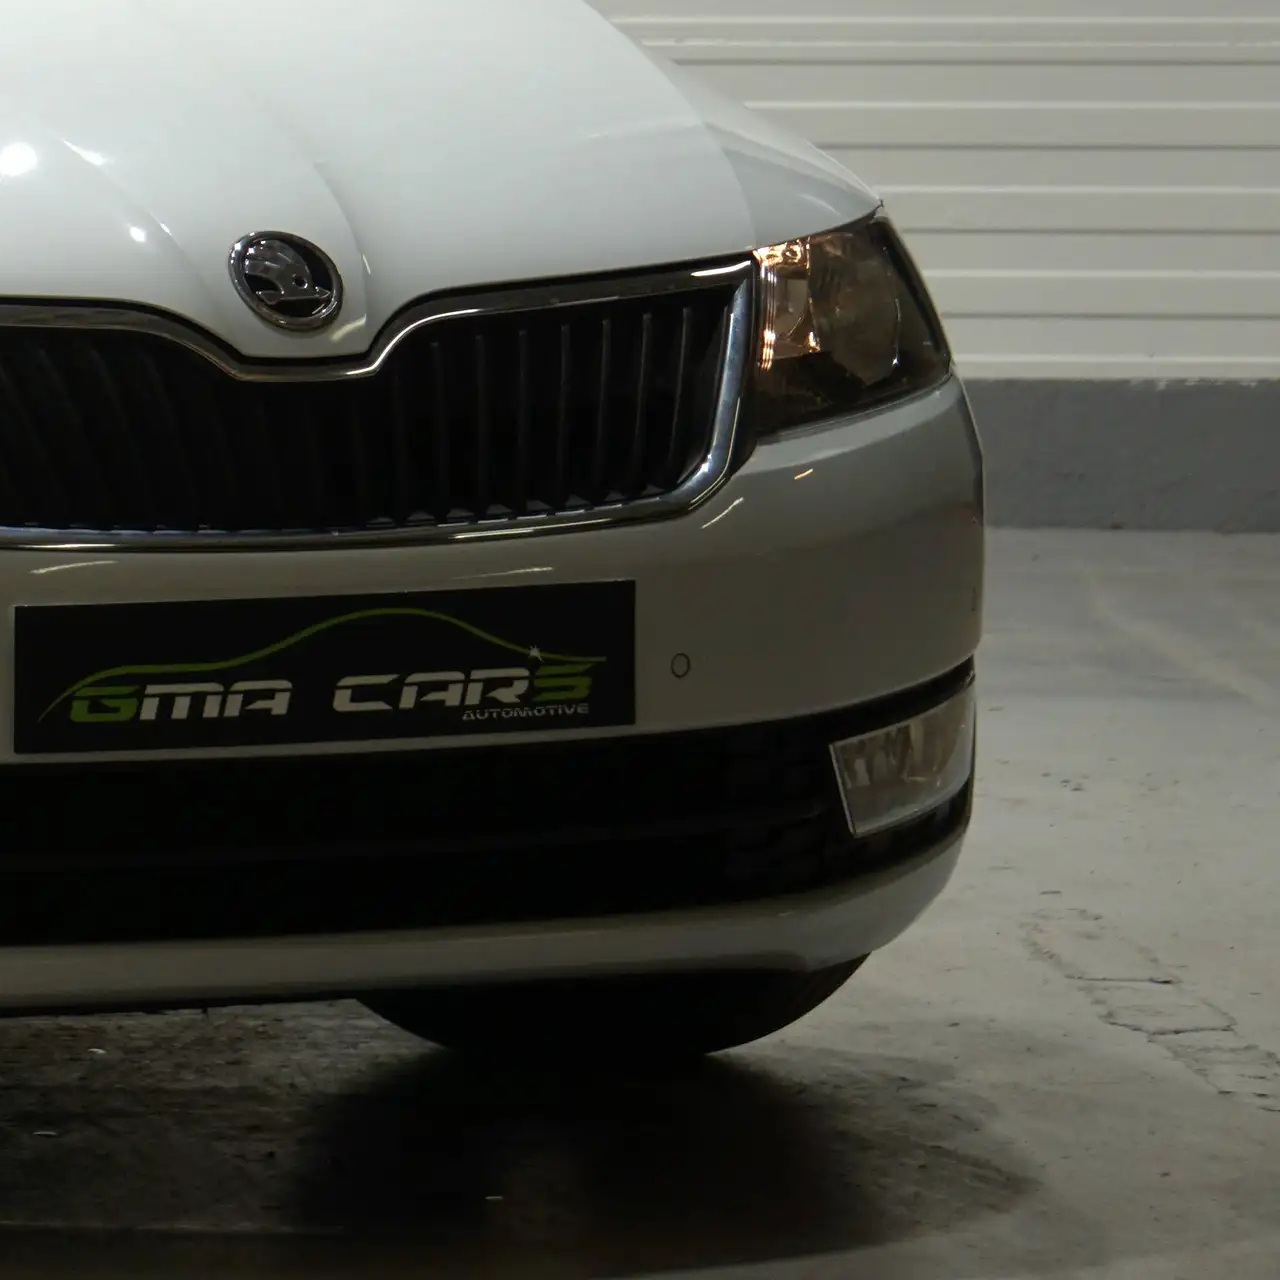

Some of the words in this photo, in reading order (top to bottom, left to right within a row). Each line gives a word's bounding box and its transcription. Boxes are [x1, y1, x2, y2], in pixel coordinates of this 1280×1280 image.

[70, 679, 294, 722] GMA
[333, 664, 594, 713] CARS
[461, 703, 590, 721] AUTOMOTIVE
